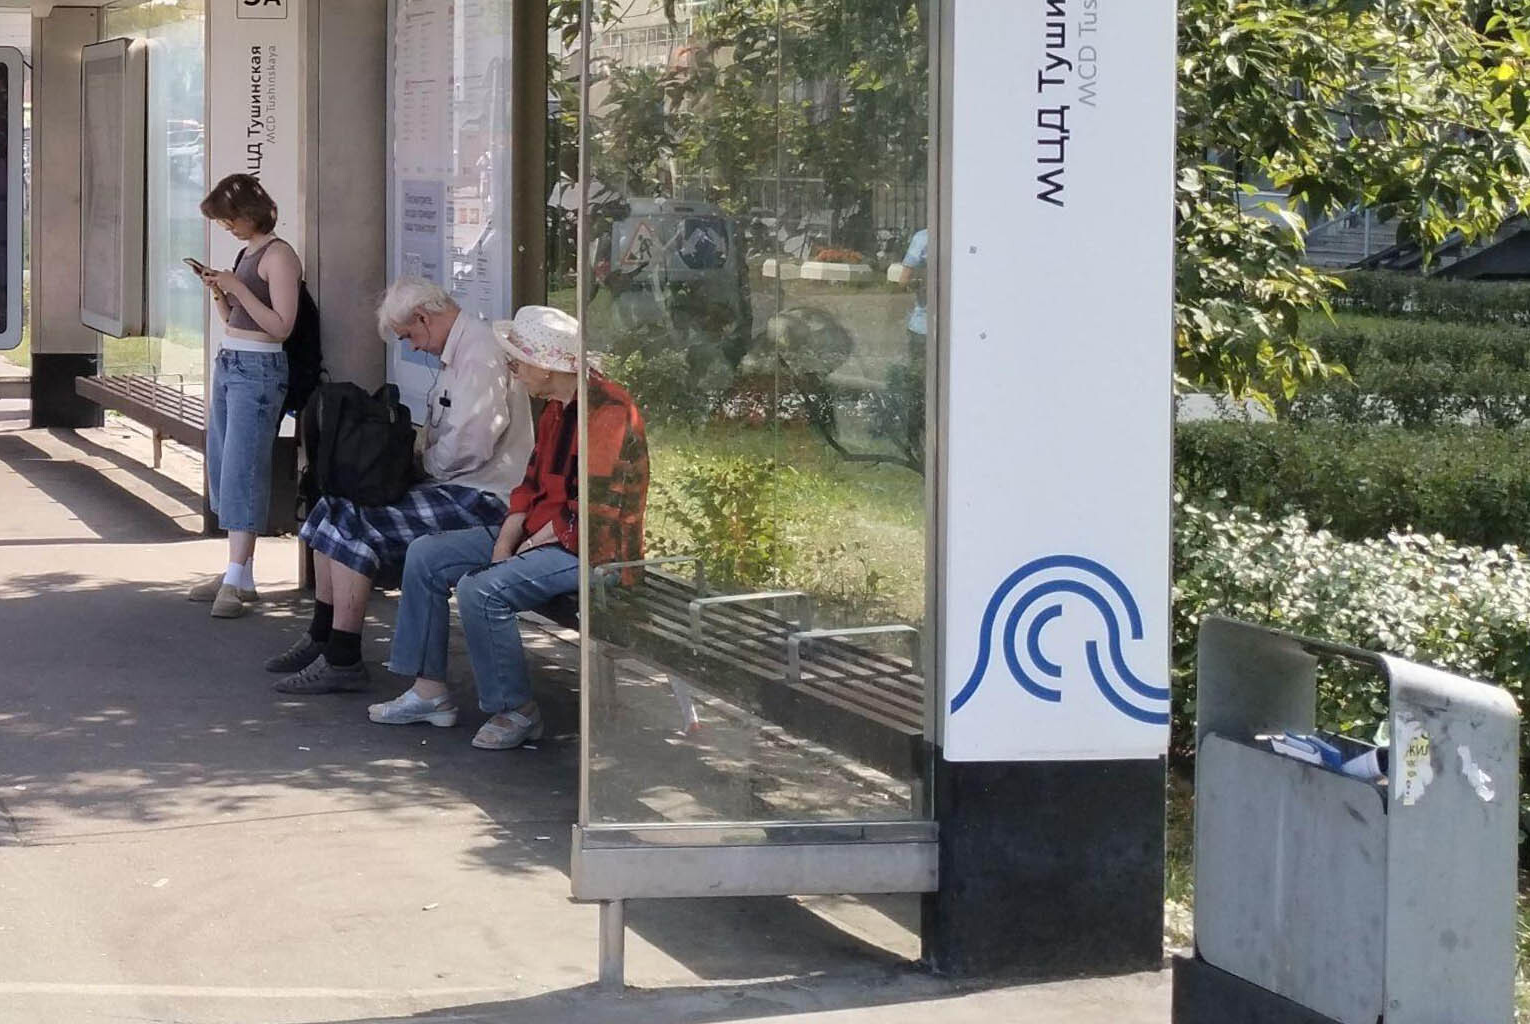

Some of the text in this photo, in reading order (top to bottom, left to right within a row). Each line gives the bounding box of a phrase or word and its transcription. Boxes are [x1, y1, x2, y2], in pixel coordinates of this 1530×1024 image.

[246, 45, 264, 138] Тушинская
[266, 45, 279, 145] MCD Tushinskaya
[1077, 45, 1098, 108] MCD
[1036, 105, 1071, 208] МЦД
